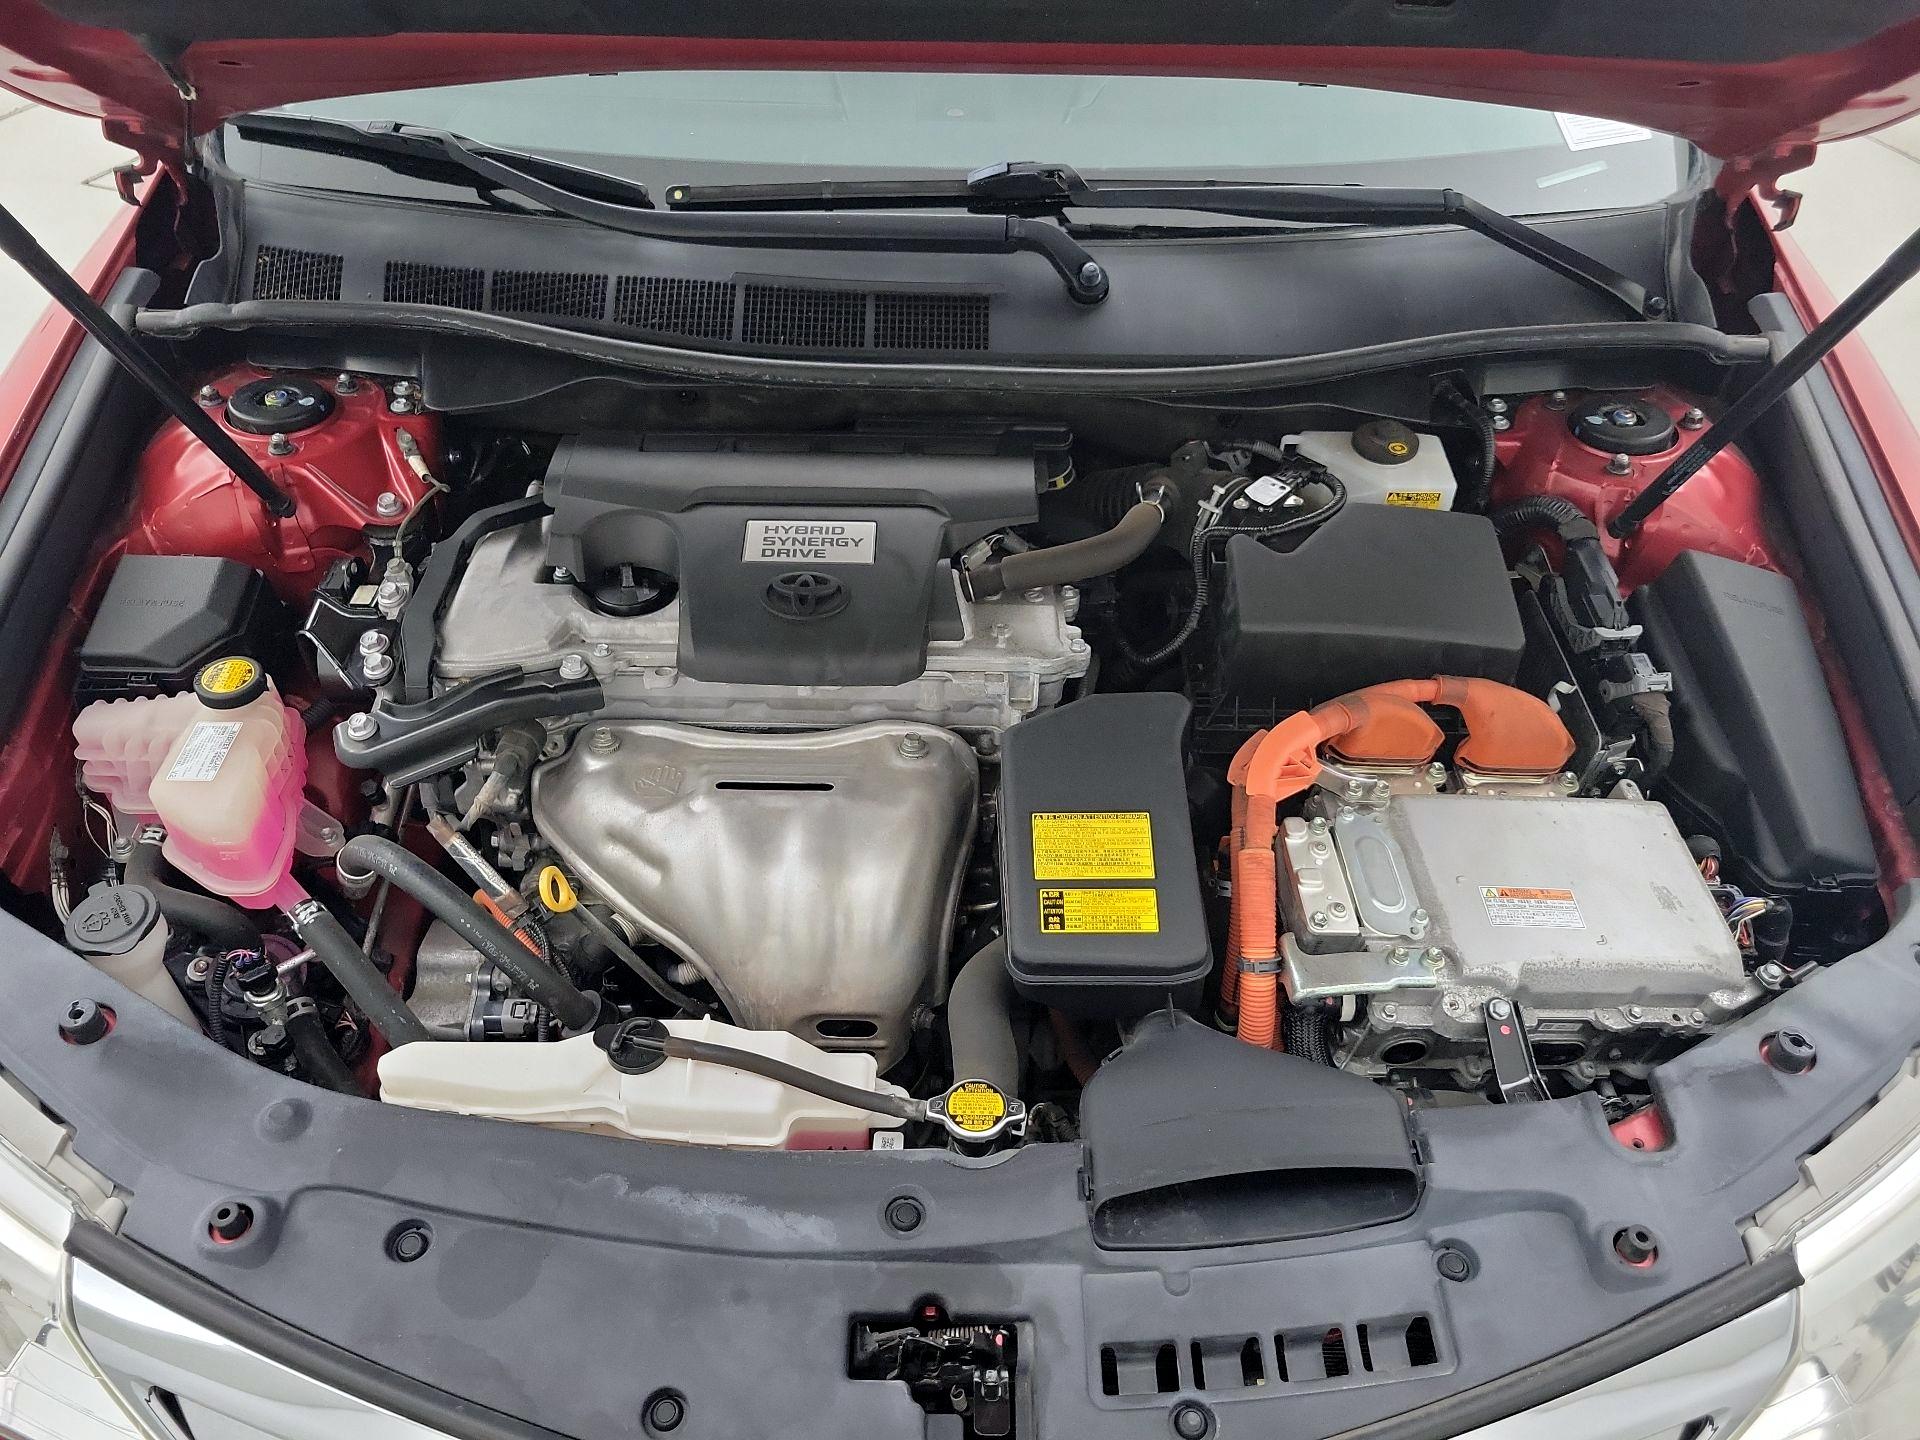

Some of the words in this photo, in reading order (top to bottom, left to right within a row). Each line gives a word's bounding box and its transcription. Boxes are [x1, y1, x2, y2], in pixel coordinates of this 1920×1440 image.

[764, 525, 845, 535] HYBRID
[762, 536, 864, 547] SYNERGY
[761, 548, 827, 558] DRIVE
